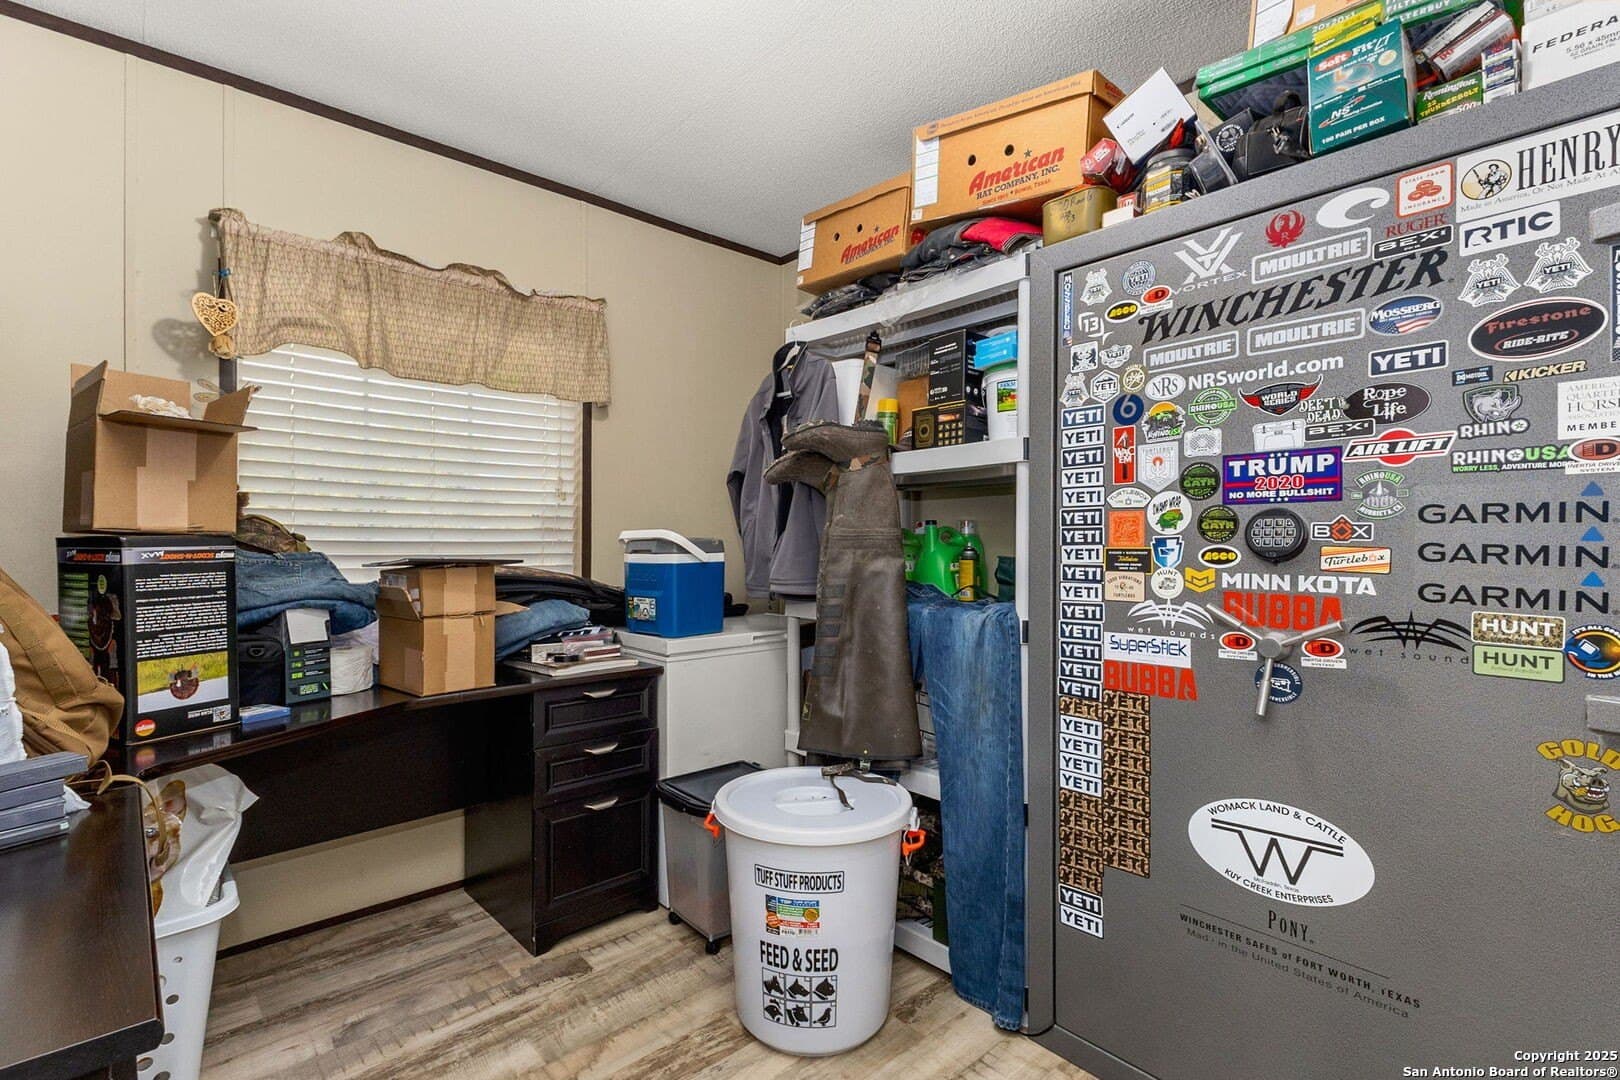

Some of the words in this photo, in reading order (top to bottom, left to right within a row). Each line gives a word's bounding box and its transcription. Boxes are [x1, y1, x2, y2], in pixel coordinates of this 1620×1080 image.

[1533, 15, 1618, 53] FEDERA
[1335, 129, 1352, 139] PAIR
[1353, 122, 1368, 133] PER
[1516, 124, 1620, 191] HENRY
[968, 147, 1065, 196] American
[976, 188, 992, 200] HAT
[1041, 164, 1061, 177] INC.
[1386, 213, 1447, 239] RUGER
[1464, 211, 1554, 249] RTIC
[841, 224, 900, 264] American
[1259, 237, 1363, 276] MOULTRIE
[1543, 264, 1573, 275] YETI
[1171, 270, 1248, 297] VORTEX
[1476, 278, 1502, 289] YETI
[1138, 249, 1449, 346] WINCHESTER
[1370, 300, 1441, 321] MOSSBERG
[1484, 305, 1593, 334] Firestone
[1083, 316, 1099, 333] 13
[1255, 318, 1357, 348] MOULTRIE
[1502, 331, 1570, 350] RIDE-RITE
[1150, 340, 1233, 367] MOULTRIE
[1374, 347, 1442, 372] YETI
[1189, 356, 1344, 391] NRSworld.com
[1515, 361, 1588, 382] KICKER
[1095, 382, 1116, 391] YETI
[1151, 374, 1179, 398] NRS
[1261, 390, 1298, 401] WORLD
[1363, 386, 1407, 401] Rope
[1064, 409, 1102, 424] YETI
[1190, 401, 1235, 413] RHINOUSA
[1366, 402, 1407, 420] Life
[1460, 419, 1528, 438] RHINO
[1566, 421, 1617, 432] MEMBE
[1065, 430, 1101, 444] YETI
[1064, 449, 1102, 464] YETI
[1351, 441, 1393, 457] AIR
[1395, 437, 1449, 454] LIFT
[1501, 461, 1547, 470] ADVENTURE
[1064, 471, 1100, 484] YETI
[1254, 474, 1305, 491] 2020
[1358, 471, 1401, 484] RHINOUSA
[1064, 490, 1101, 504] YETI
[1229, 491, 1244, 499] NO
[1246, 490, 1276, 498] MORE
[1279, 487, 1334, 498] BULLSHIT
[1063, 511, 1100, 525] YETI
[1418, 501, 1609, 524] GARMIN
[1063, 531, 1100, 543] YETI
[1064, 549, 1100, 560] YETI
[1203, 551, 1237, 561] ASCO
[1418, 543, 1609, 569] GARMIN
[1063, 567, 1100, 580] YETI
[1157, 569, 1178, 577] HUNT
[1062, 586, 1099, 598] YETI
[1222, 573, 1290, 591] MINN
[1298, 574, 1377, 596] KOTA
[1418, 583, 1609, 614] GARMIN
[1064, 604, 1100, 617] YETI
[1062, 624, 1099, 637] YETI
[1481, 618, 1557, 637] HUNT
[1062, 643, 1099, 659] YETI
[1110, 634, 1188, 657] SuperStick
[1349, 647, 1384, 657] wet
[1483, 651, 1555, 670] HUNT
[1061, 662, 1099, 679] YETI
[1060, 681, 1098, 698] YETI
[1104, 660, 1198, 701] BUBBA
[1062, 718, 1099, 737] YETI
[1062, 737, 1098, 756] YETI
[1062, 756, 1098, 775] YETI
[1062, 774, 1098, 793] YETI
[1207, 801, 1257, 816] WOMACK
[1259, 802, 1290, 816] LAND
[1293, 811, 1302, 820] &
[1305, 816, 1347, 845] CATTLE
[756, 867, 774, 885] TUFF
[774, 872, 798, 890] STUFF
[799, 874, 842, 891] PRODUCTS
[1224, 867, 1241, 881] KUY
[1242, 878, 1273, 896] CREEK
[1275, 890, 1334, 904] ENTERPRISES
[1061, 889, 1100, 914] YETI
[1063, 909, 1100, 933] YETI
[1268, 910, 1310, 942] PONY
[760, 939, 790, 969] FEED
[792, 947, 803, 972] &
[805, 947, 839, 973] SEED
[1180, 912, 1242, 943] WINCHESTER
[1245, 937, 1278, 956] SAFES
[1282, 952, 1292, 960] of
[1296, 955, 1323, 973] FORT
[1381, 986, 1421, 1010] TEXAS
[1186, 928, 1213, 943] Mad
[1217, 940, 1228, 949] in
[1251, 950, 1290, 973] United
[1293, 965, 1334, 989] States
[1336, 985, 1349, 996] of
[1352, 990, 1409, 1018] America
